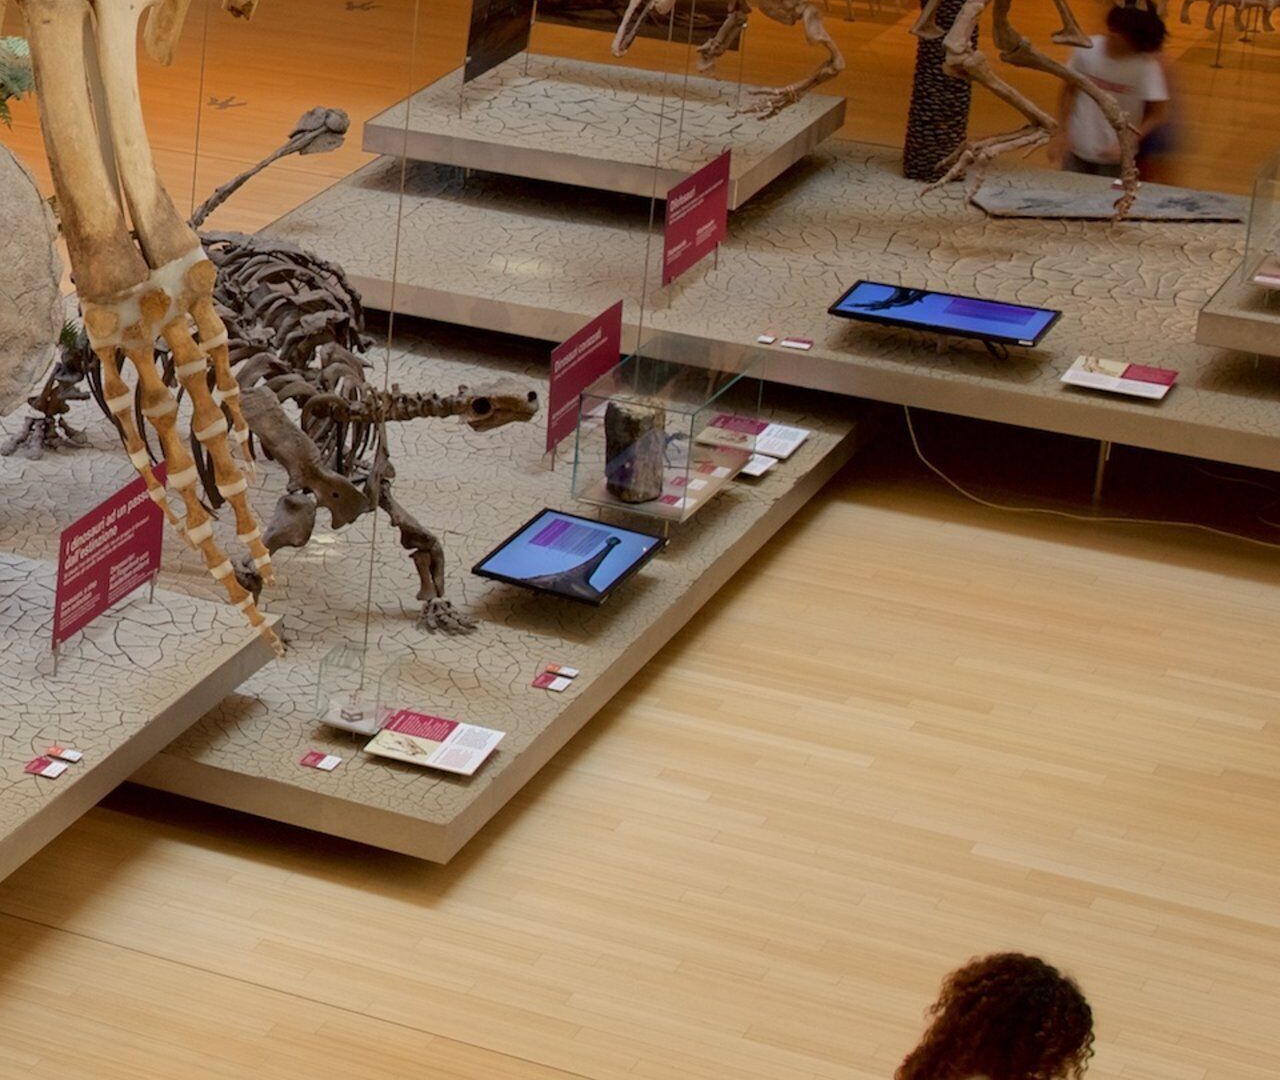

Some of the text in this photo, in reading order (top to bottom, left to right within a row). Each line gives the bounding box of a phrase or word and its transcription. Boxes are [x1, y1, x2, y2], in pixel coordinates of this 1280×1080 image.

[64, 525, 119, 570] dall'estinzione
[70, 516, 106, 552] dinosauri
[105, 509, 117, 527] ad
[116, 504, 128, 520] un
